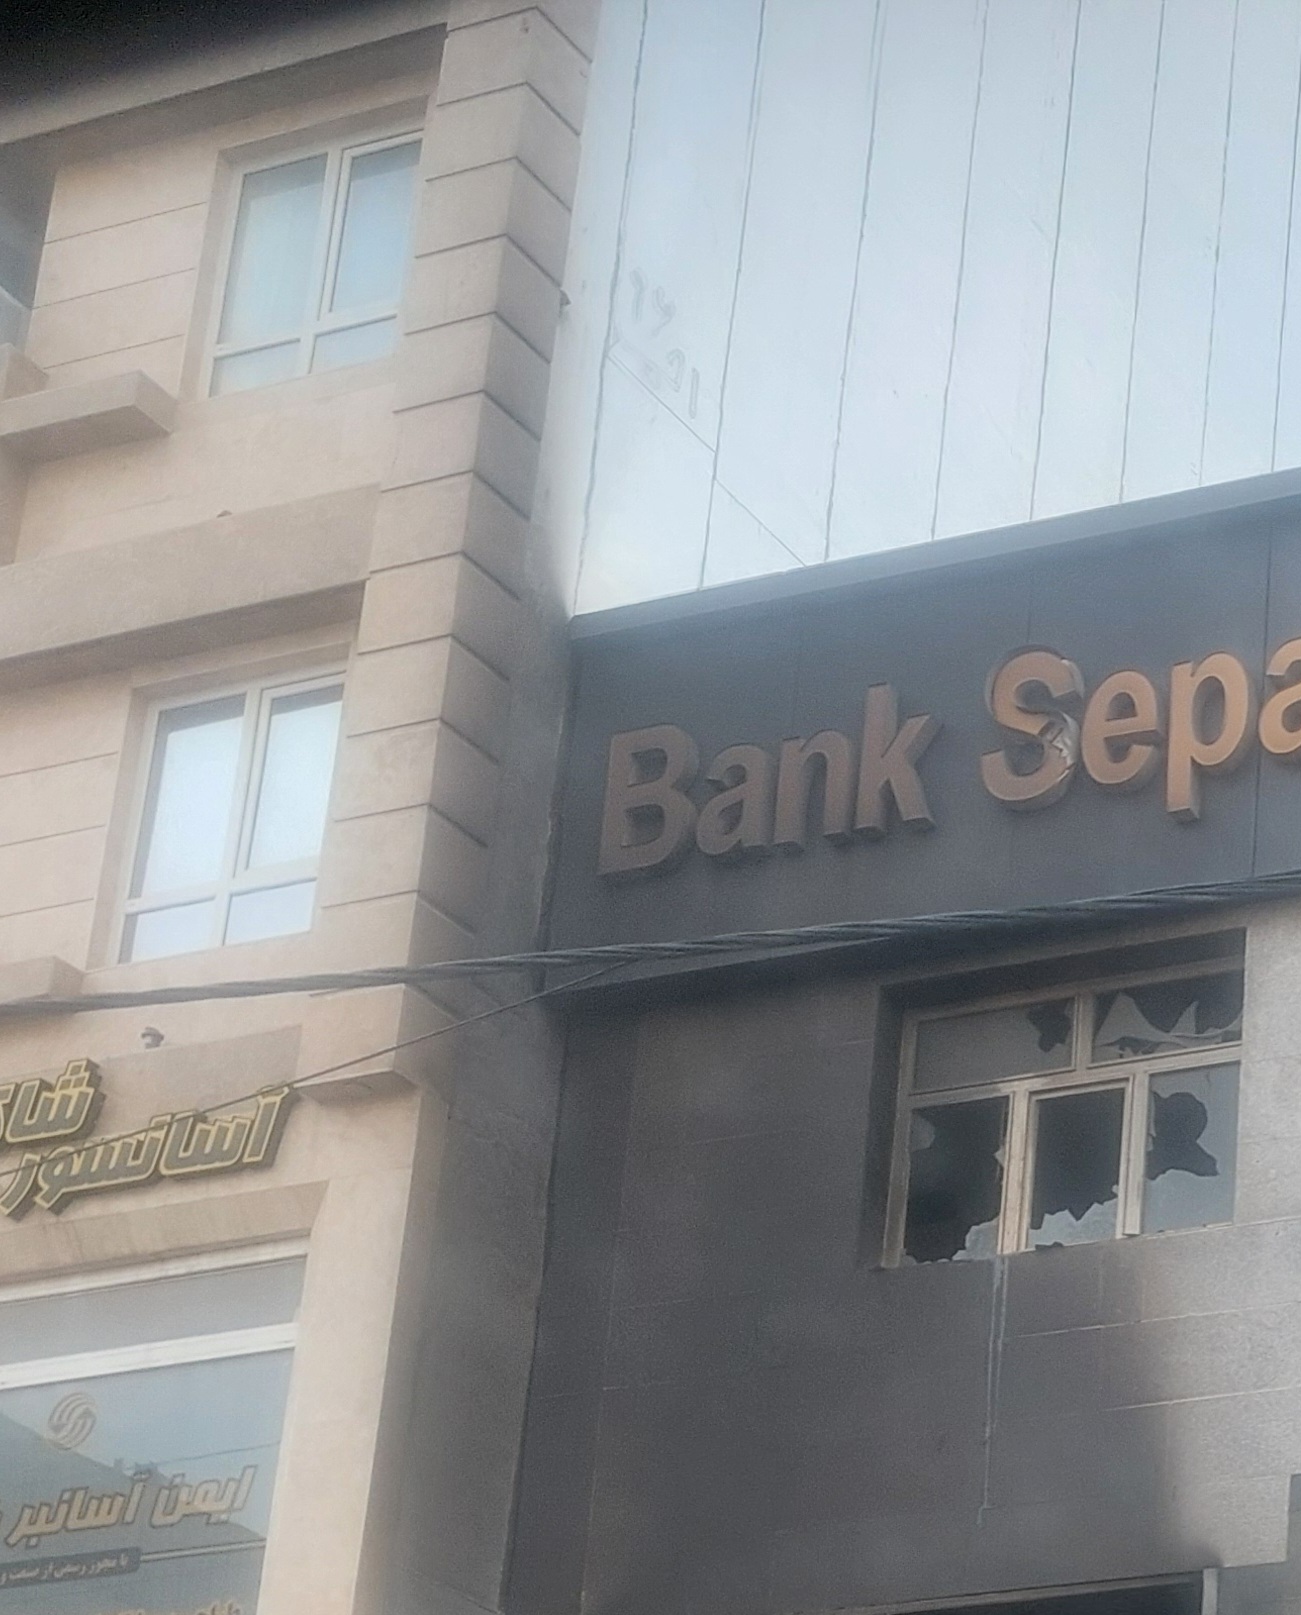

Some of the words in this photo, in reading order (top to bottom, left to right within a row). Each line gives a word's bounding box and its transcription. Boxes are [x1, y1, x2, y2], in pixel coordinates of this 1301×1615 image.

[599, 682, 942, 877] Bank
[0, 1082, 291, 1217] آسانسور
[4, 1471, 149, 1549] آسانبر
[149, 1464, 259, 1530] ایمن
